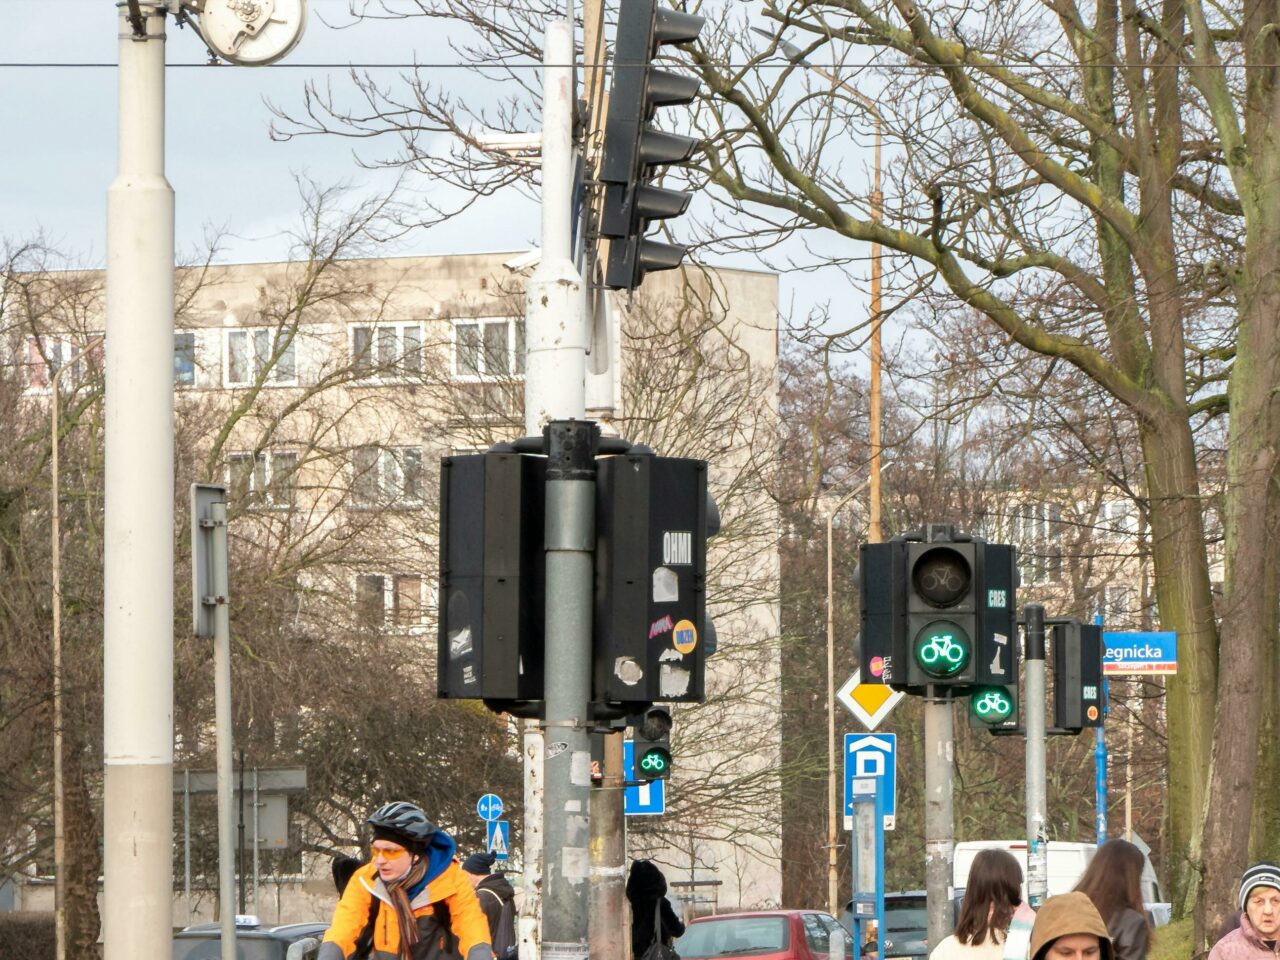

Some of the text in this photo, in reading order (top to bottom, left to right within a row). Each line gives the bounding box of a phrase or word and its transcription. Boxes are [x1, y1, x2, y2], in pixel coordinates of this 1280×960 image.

[663, 531, 692, 564] OHMI
[989, 590, 1006, 608] CRES
[1103, 644, 1162, 662] egnicka
